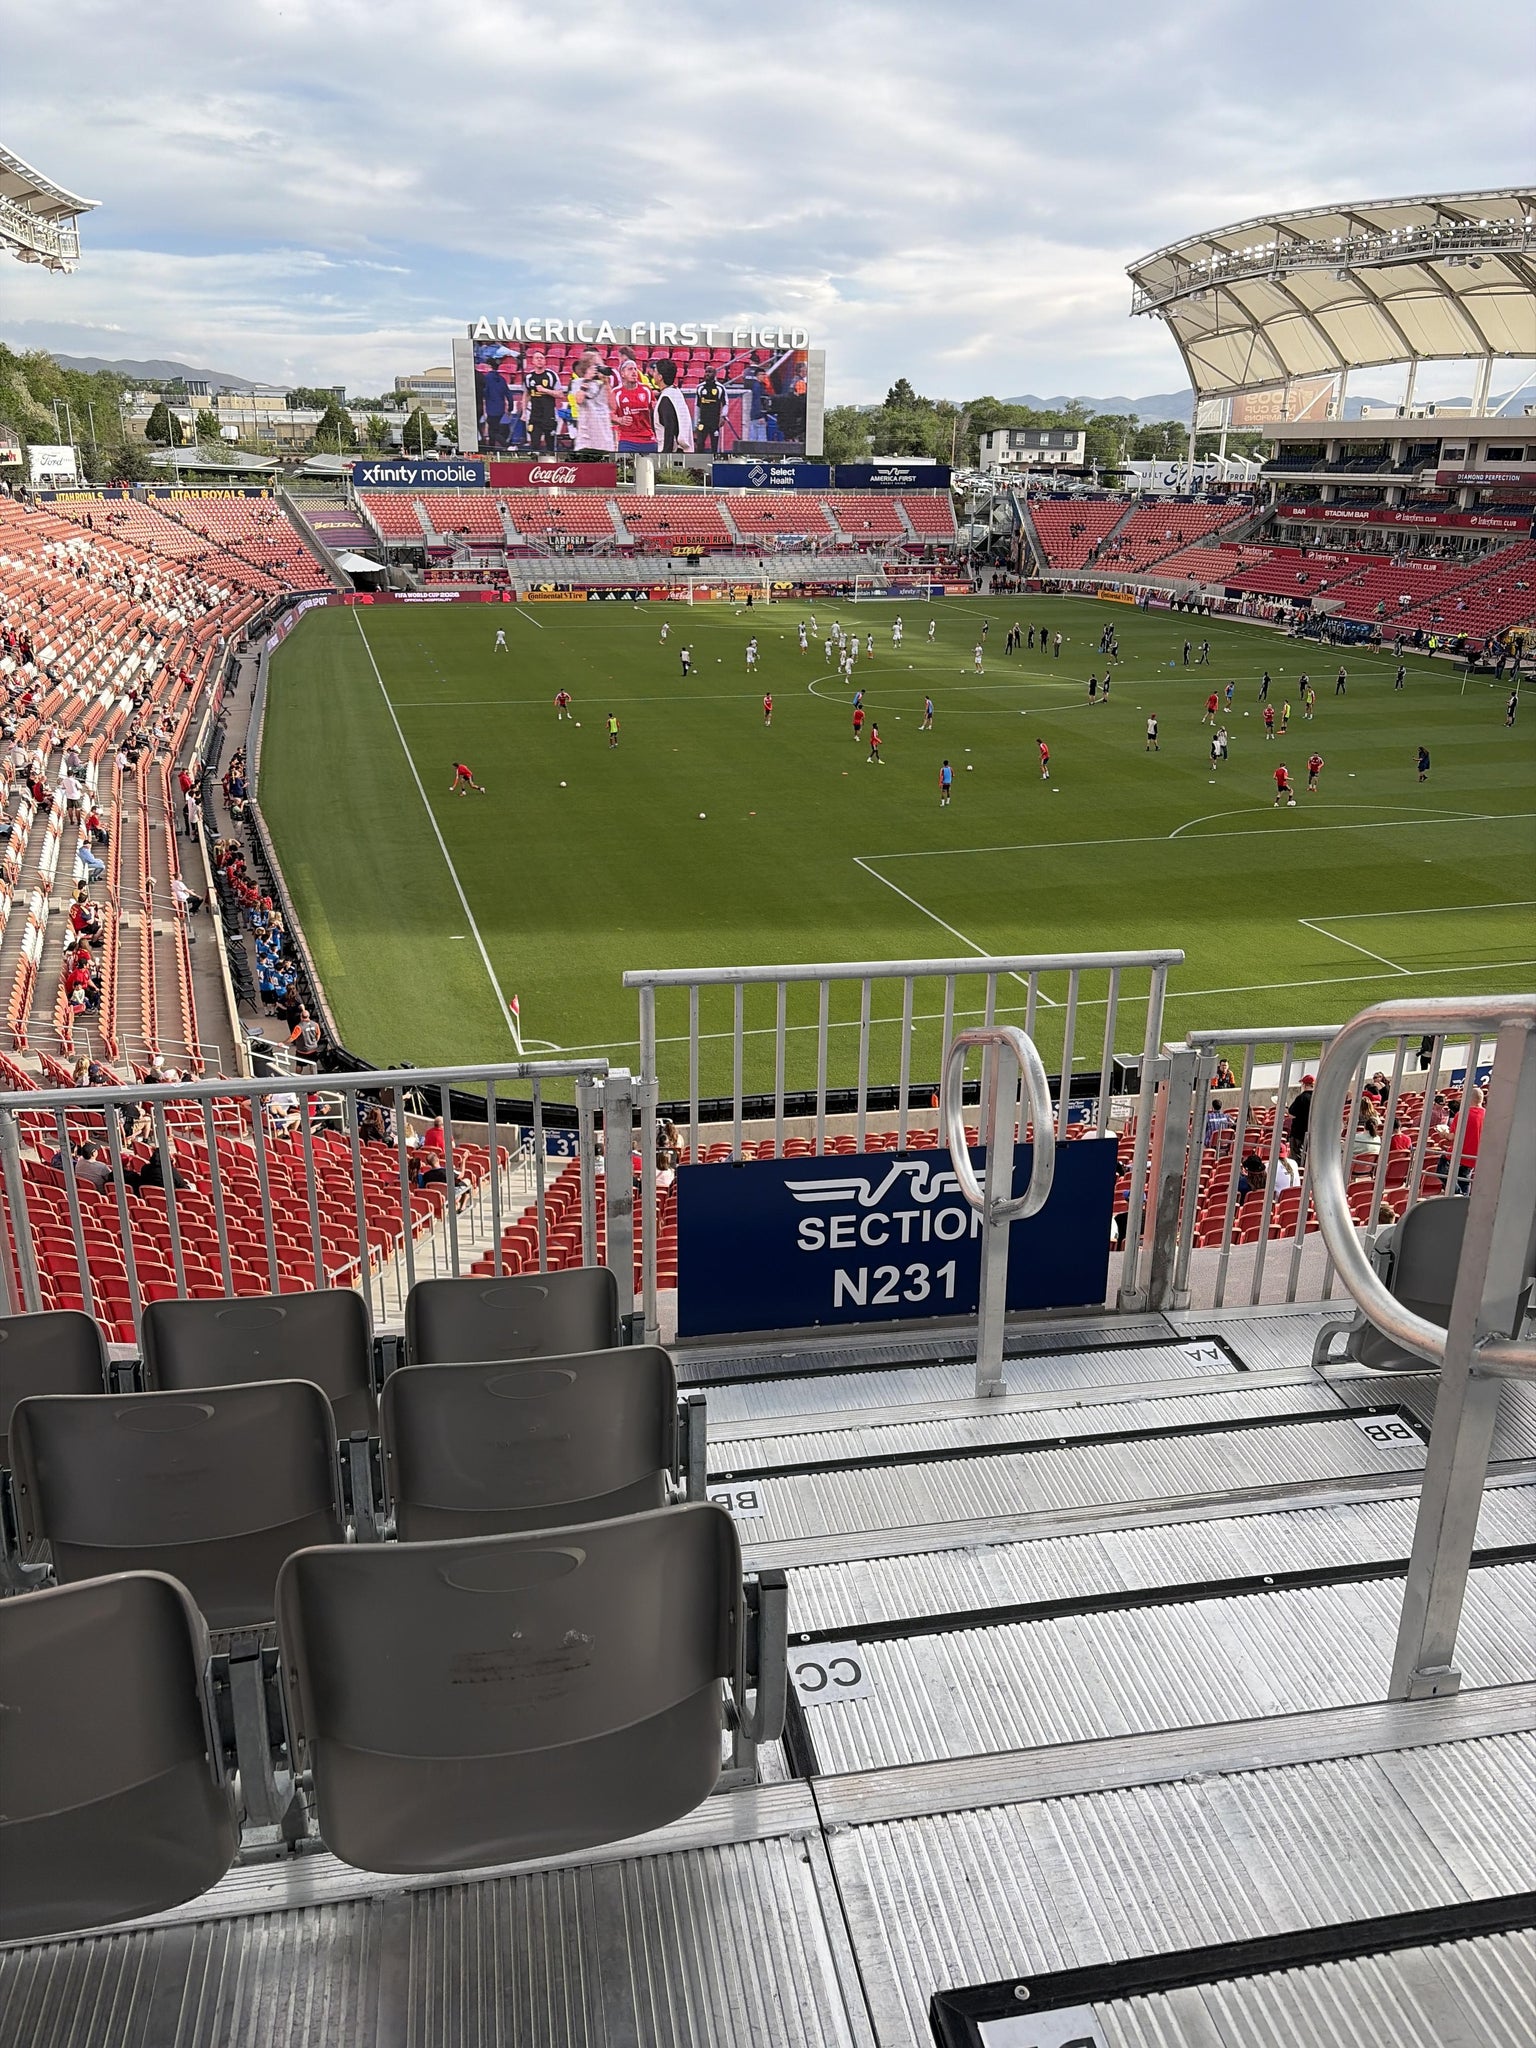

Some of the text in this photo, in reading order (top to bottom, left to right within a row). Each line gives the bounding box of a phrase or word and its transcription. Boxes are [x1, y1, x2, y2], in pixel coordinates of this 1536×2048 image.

[473, 315, 809, 349] AMERICA FIRST FIELD
[40, 454, 63, 466] Ford
[362, 465, 476, 484] xfinity mobile
[770, 467, 795, 476] Select
[770, 476, 794, 484] Health
[170, 490, 245, 500] UTAH ROYALS
[1325, 510, 1354, 518] STADIUM
[1503, 519, 1517, 527] CLUB
[675, 536, 684, 544] LA
[687, 536, 710, 544] BARRA
[713, 536, 729, 544] REAL
[1423, 563, 1437, 571] CLUB
[528, 592, 562, 600] Continental
[1275, 597, 1293, 606] LAKE
[833, 1260, 956, 1308] N231
[1184, 1348, 1219, 1362] AA
[1364, 1423, 1414, 1441] BB
[795, 1657, 862, 1692] CC
